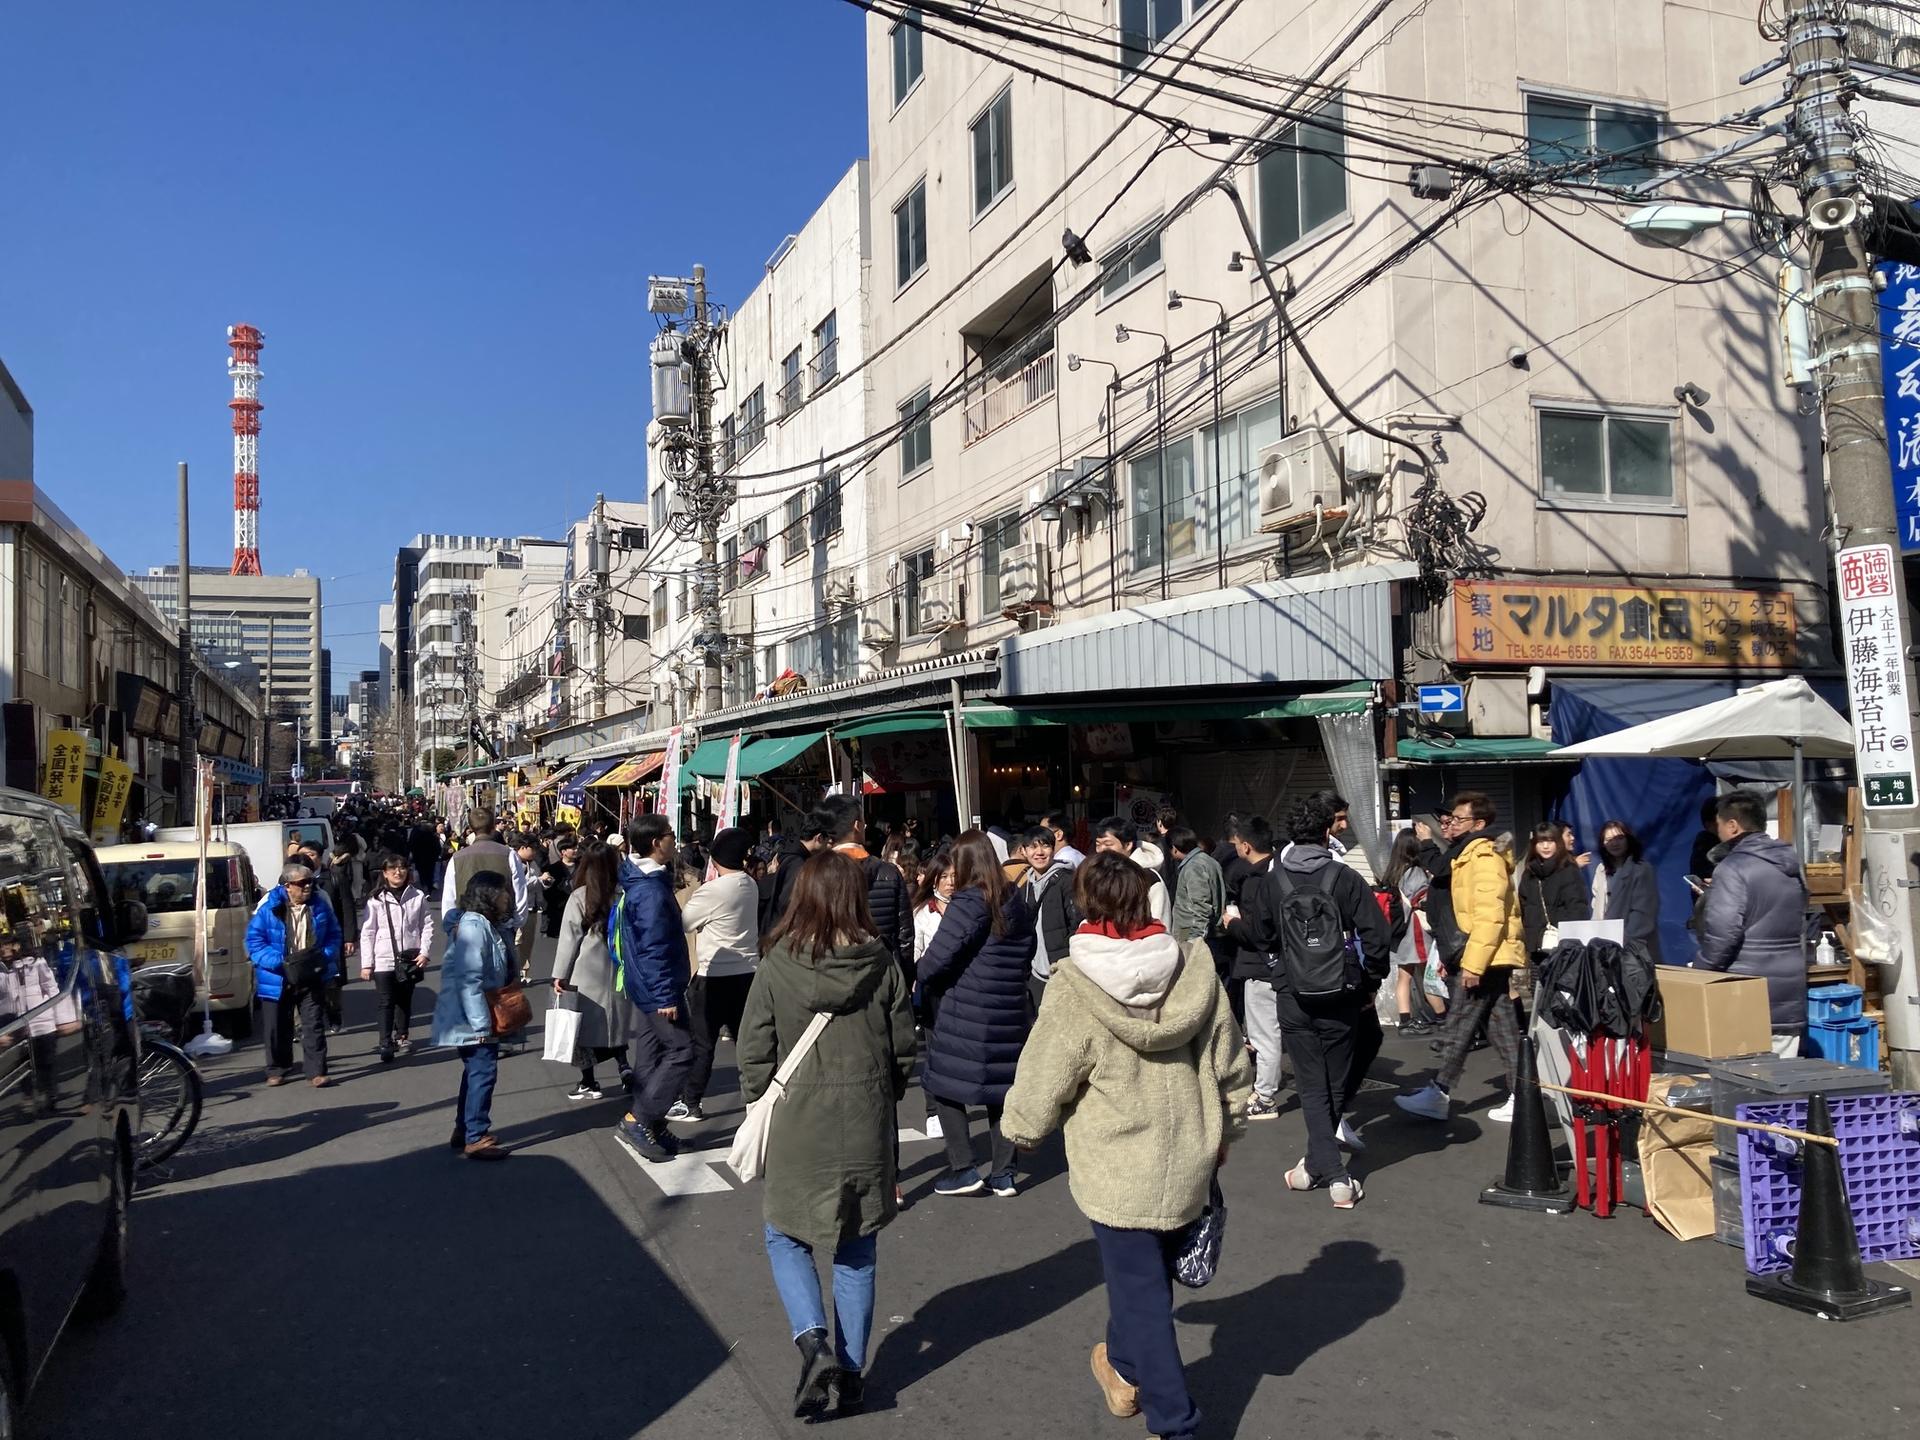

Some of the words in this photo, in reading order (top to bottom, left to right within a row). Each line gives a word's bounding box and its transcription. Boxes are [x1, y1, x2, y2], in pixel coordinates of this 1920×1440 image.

[1471, 593, 1494, 652] 築地
[1503, 594, 1693, 642] マルタ食品
[1703, 619, 1743, 636] イクラ
[1751, 620, 1789, 638] 明太子
[1750, 599, 1788, 616] タラコ
[1751, 640, 1790, 658] 数の子
[1878, 605, 1902, 696] 大正十二年創業
[1847, 607, 1887, 753] 伊藤海苔店
[48, 743, 68, 799] 全国発送
[67, 744, 81, 785] 承ります
[1872, 792, 1904, 803] 4-14
